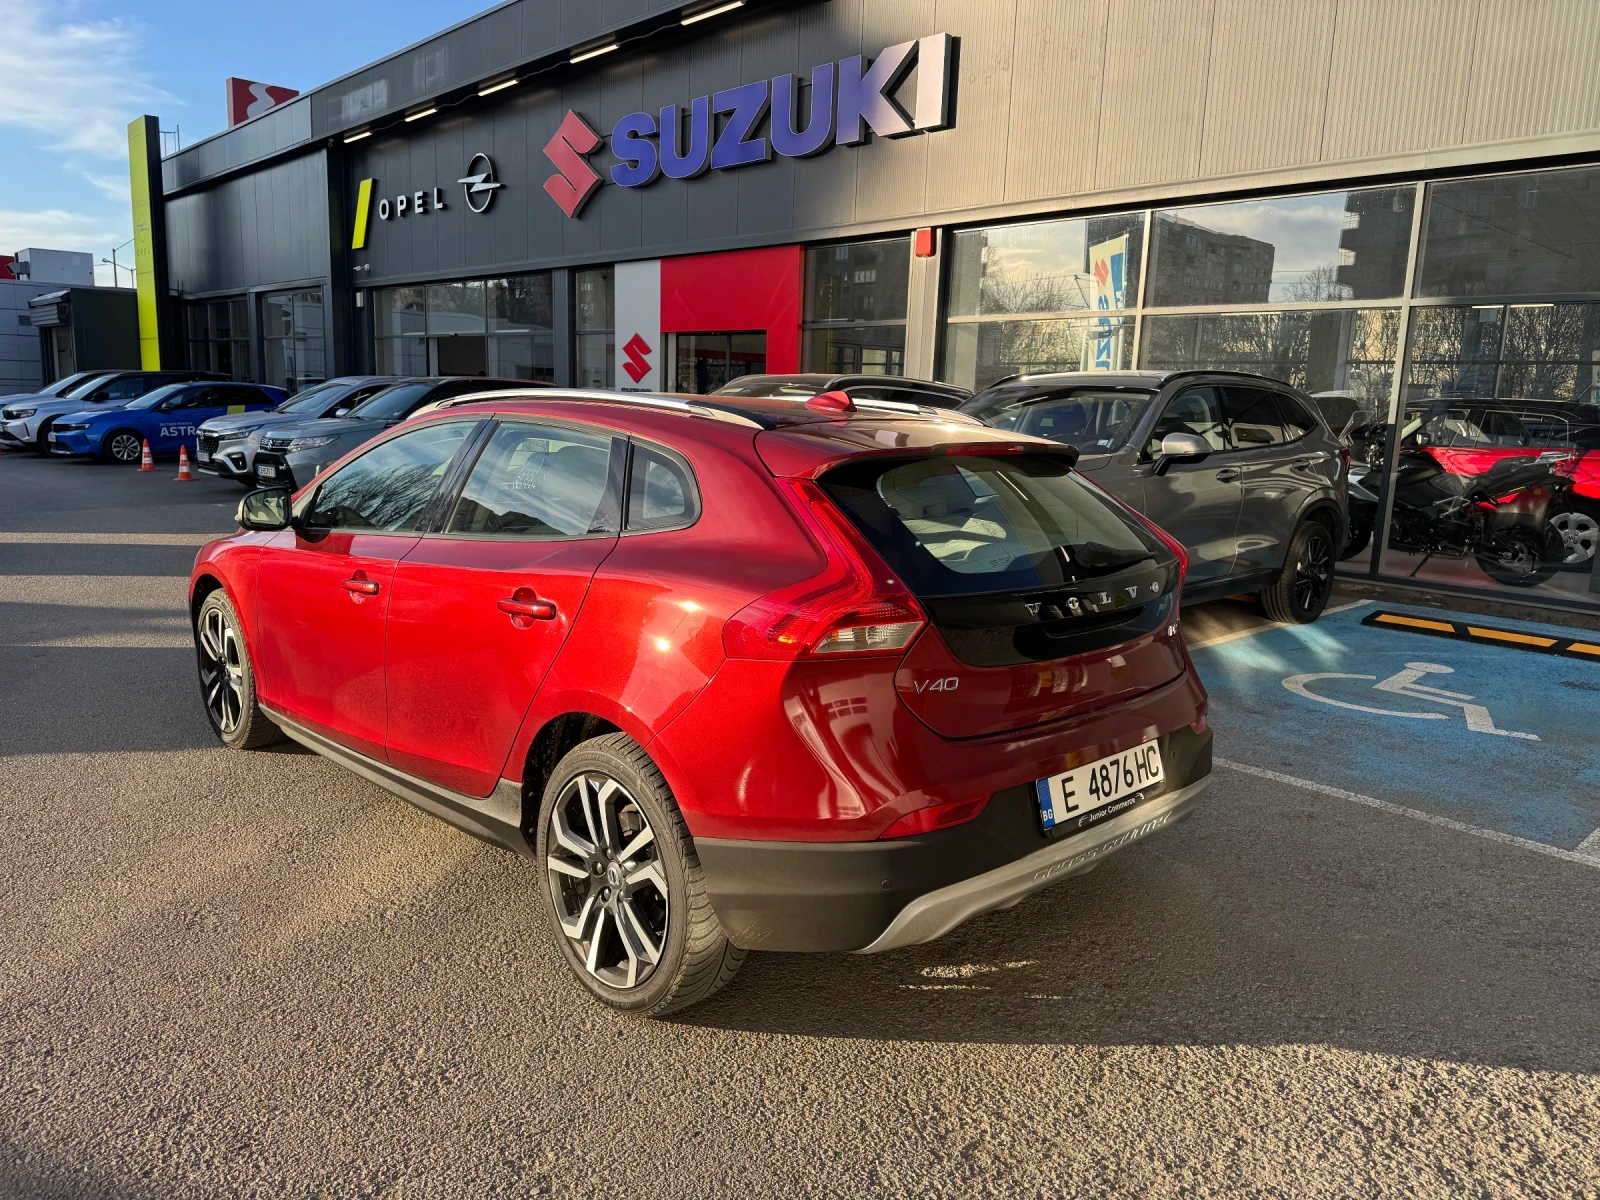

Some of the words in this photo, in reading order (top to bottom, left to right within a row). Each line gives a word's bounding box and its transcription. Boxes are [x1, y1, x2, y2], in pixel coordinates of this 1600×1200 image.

[610, 33, 952, 188] SUZUKI
[379, 187, 443, 220] OPEL
[136, 247, 151, 257] OPEL
[160, 426, 197, 437] ASTR
[1024, 581, 1160, 617] VOLVO
[914, 677, 959, 694] V40
[1061, 776, 1079, 814] E
[1089, 755, 1135, 801] 4876
[1134, 745, 1160, 784] HC
[1042, 808, 1053, 821] BG
[1089, 809, 1107, 822] Junior
[1107, 797, 1136, 814] Commerce
